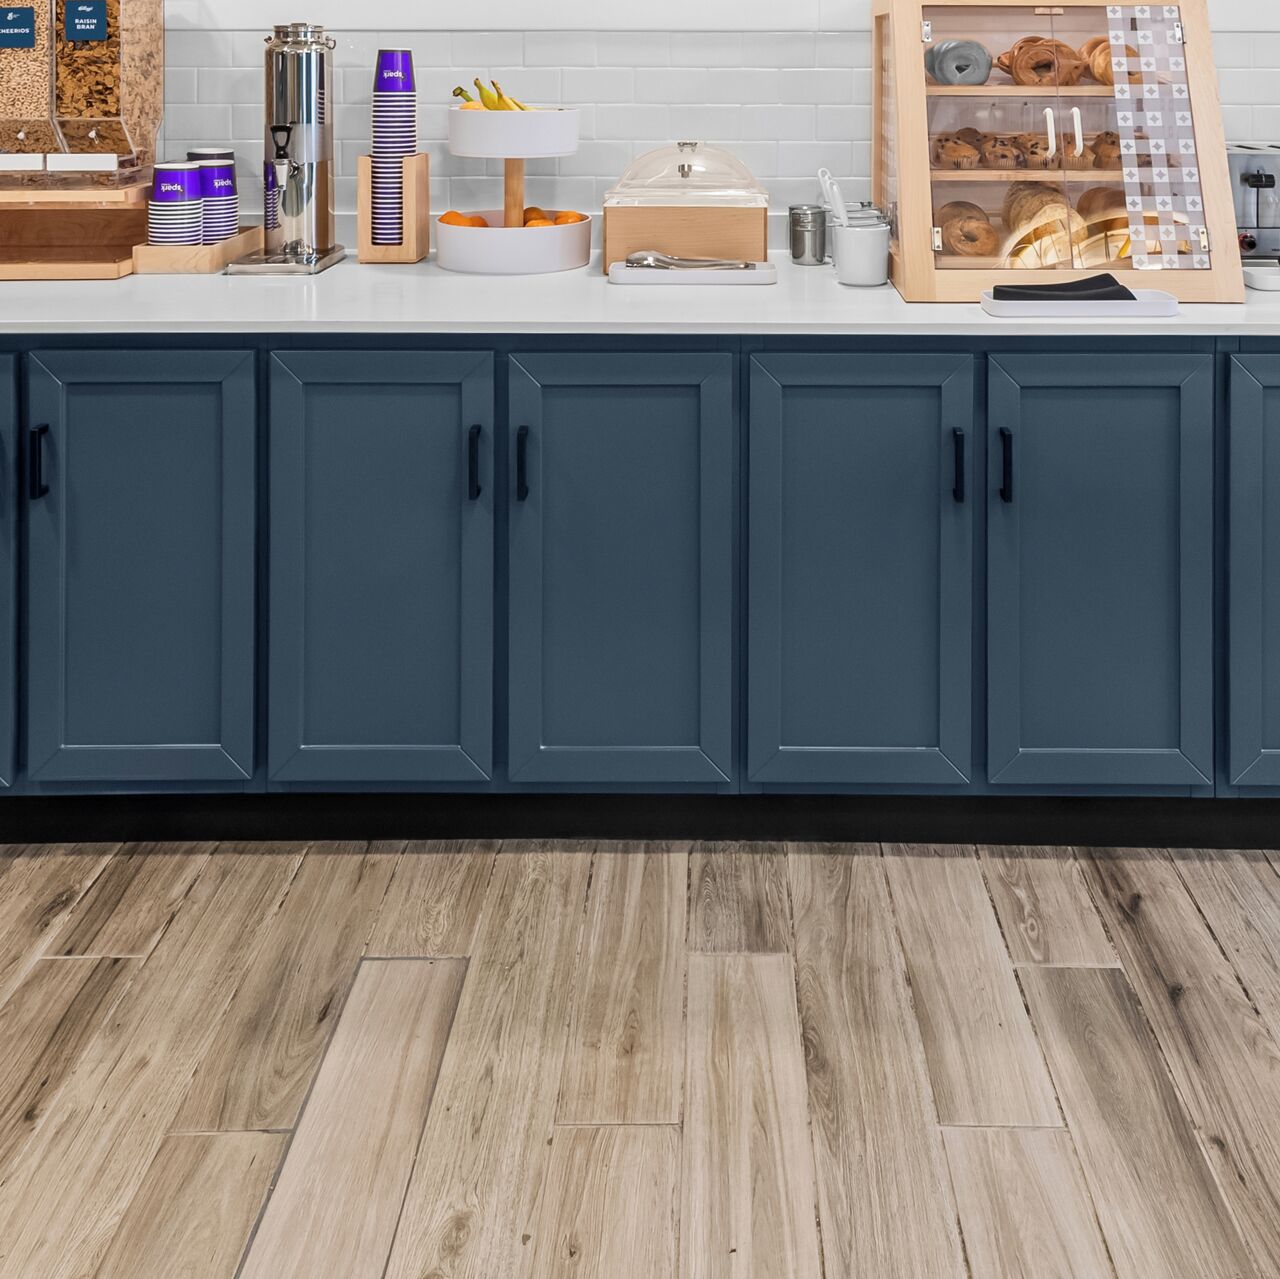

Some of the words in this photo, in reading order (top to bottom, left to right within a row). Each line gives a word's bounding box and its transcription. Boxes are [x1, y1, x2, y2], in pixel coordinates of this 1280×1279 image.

[383, 70, 402, 79] spark
[160, 183, 182, 192] spark
[213, 178, 232, 188] spark
